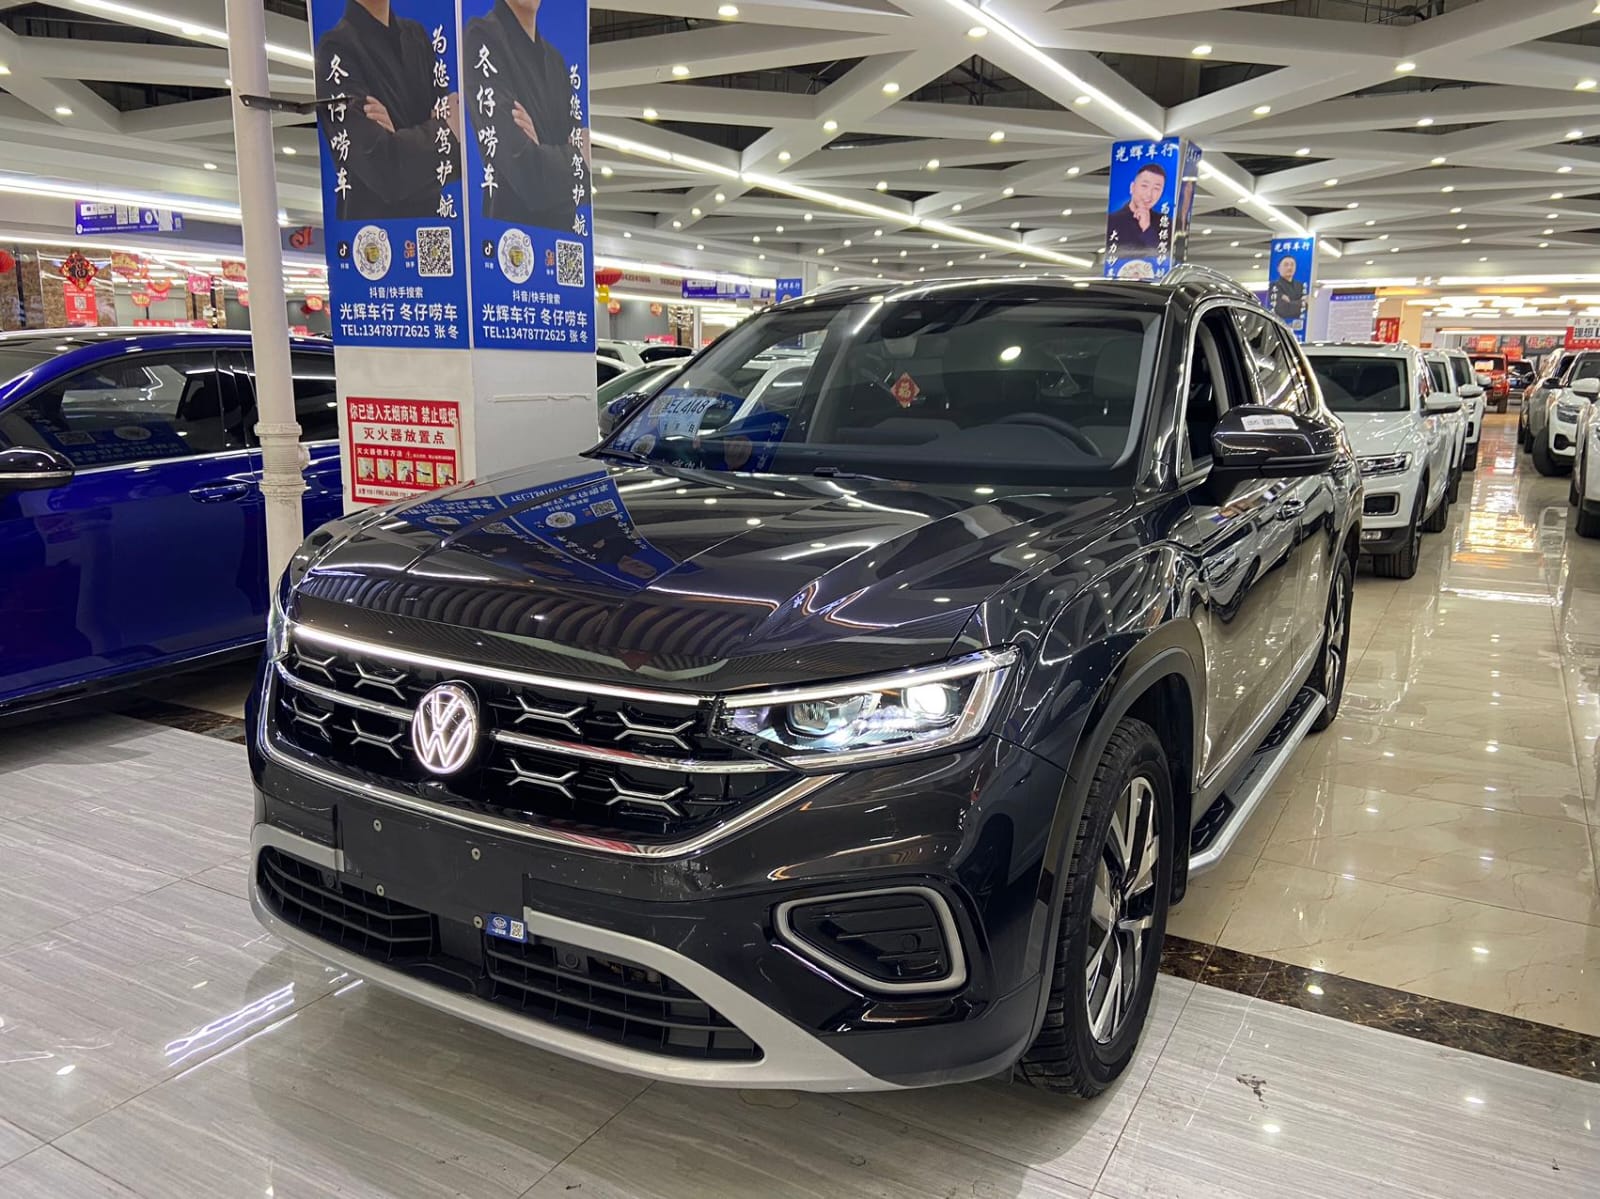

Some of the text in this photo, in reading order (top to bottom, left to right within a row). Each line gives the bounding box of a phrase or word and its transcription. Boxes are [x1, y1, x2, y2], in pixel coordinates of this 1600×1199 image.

[432, 24, 457, 219] 为您保驾护航
[474, 44, 499, 198] 冬仔唠车
[569, 63, 589, 237] 为您保驾护航
[1114, 142, 1175, 162] 光辉车行
[369, 286, 424, 299] 抖音/快手搜索
[512, 289, 561, 305] 抖音/快手搜索
[339, 303, 458, 322] 光辉车行 冬仔唠车
[482, 303, 588, 328] 光辉车行 冬仔唠车
[340, 324, 459, 340] TEL:13478772625 张冬
[482, 325, 589, 344] TEL:13478772625 张冬
[421, 406, 458, 426] 禁止吸烟
[363, 426, 445, 445] 灭火器放置点
